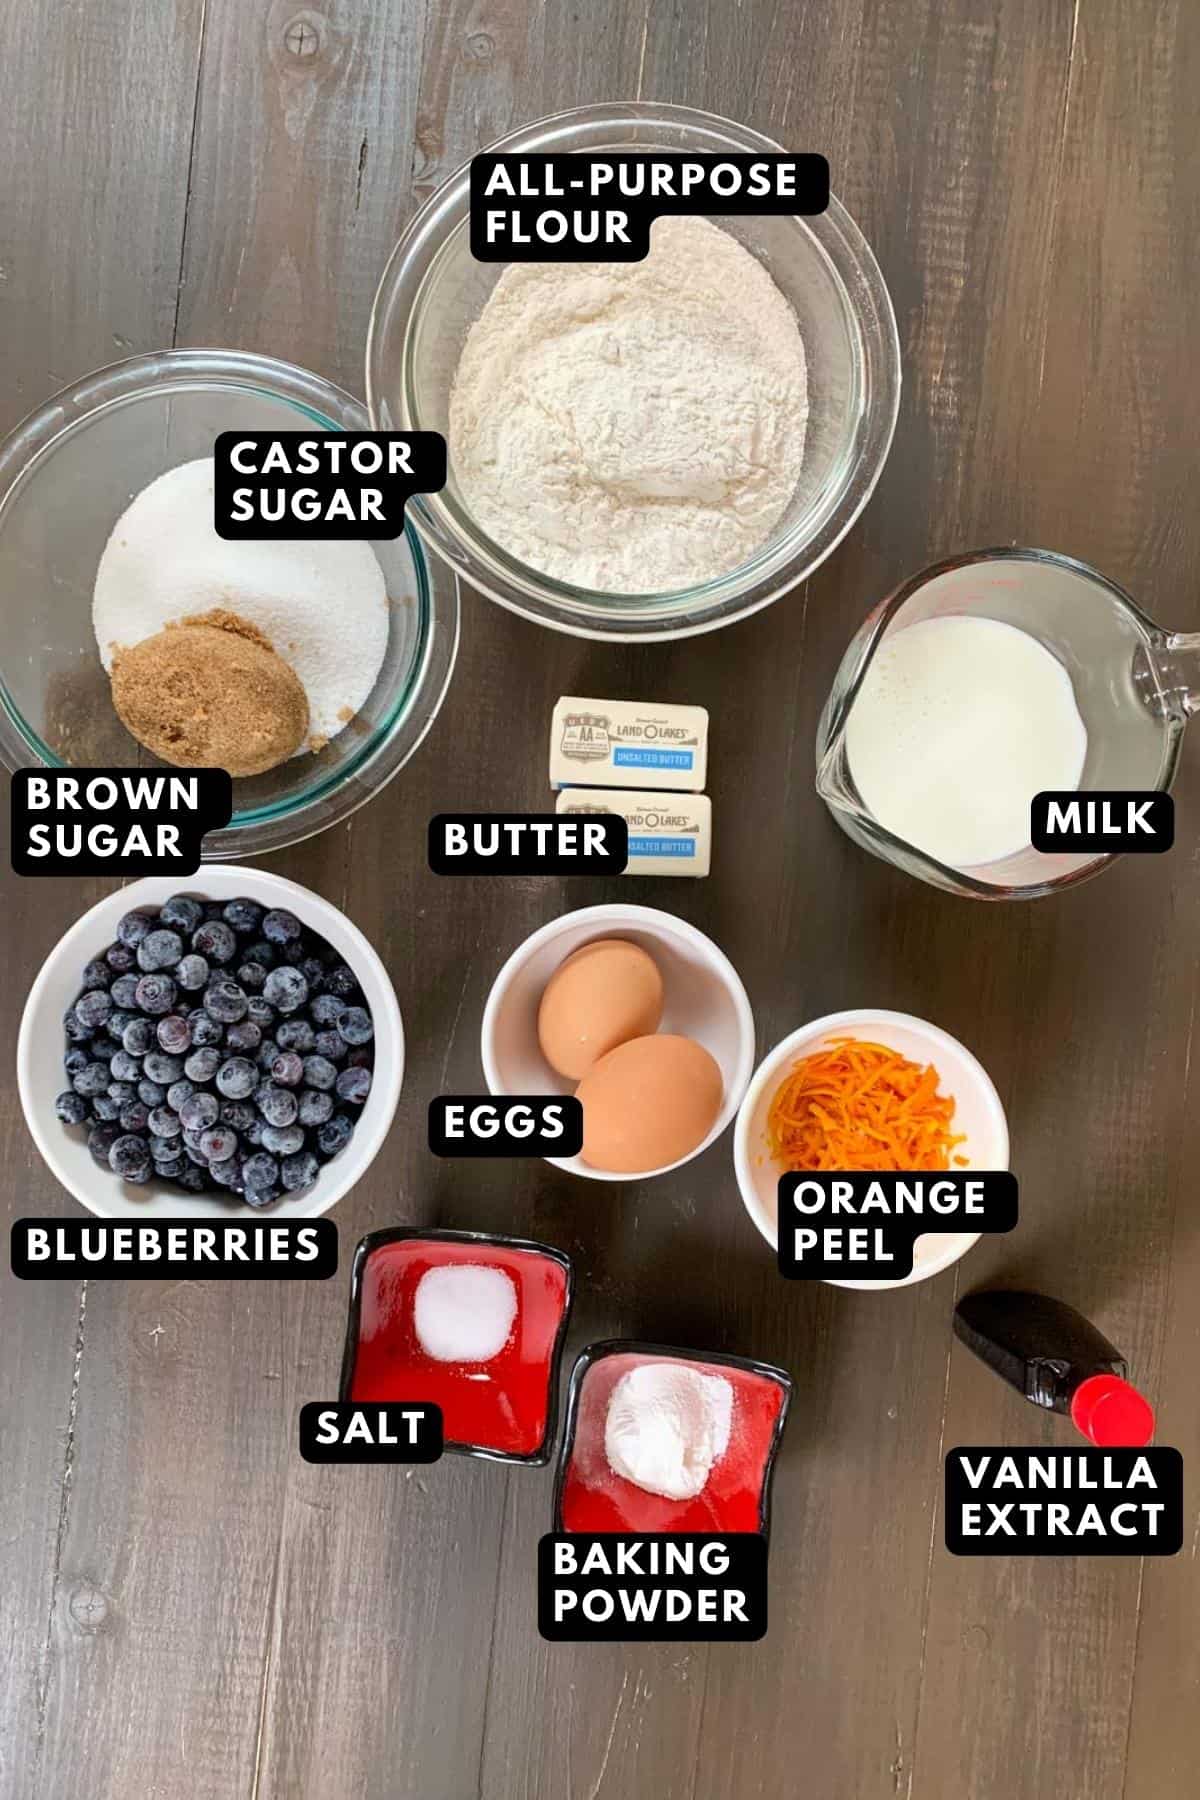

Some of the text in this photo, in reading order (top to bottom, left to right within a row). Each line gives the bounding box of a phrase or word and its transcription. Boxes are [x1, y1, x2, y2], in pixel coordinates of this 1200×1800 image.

[579, 727, 593, 741] AA
[617, 725, 642, 737] LAND
[617, 751, 657, 764] UNSALTED
[659, 754, 690, 766] BUTTER
[662, 842, 692, 853] BUTTER
